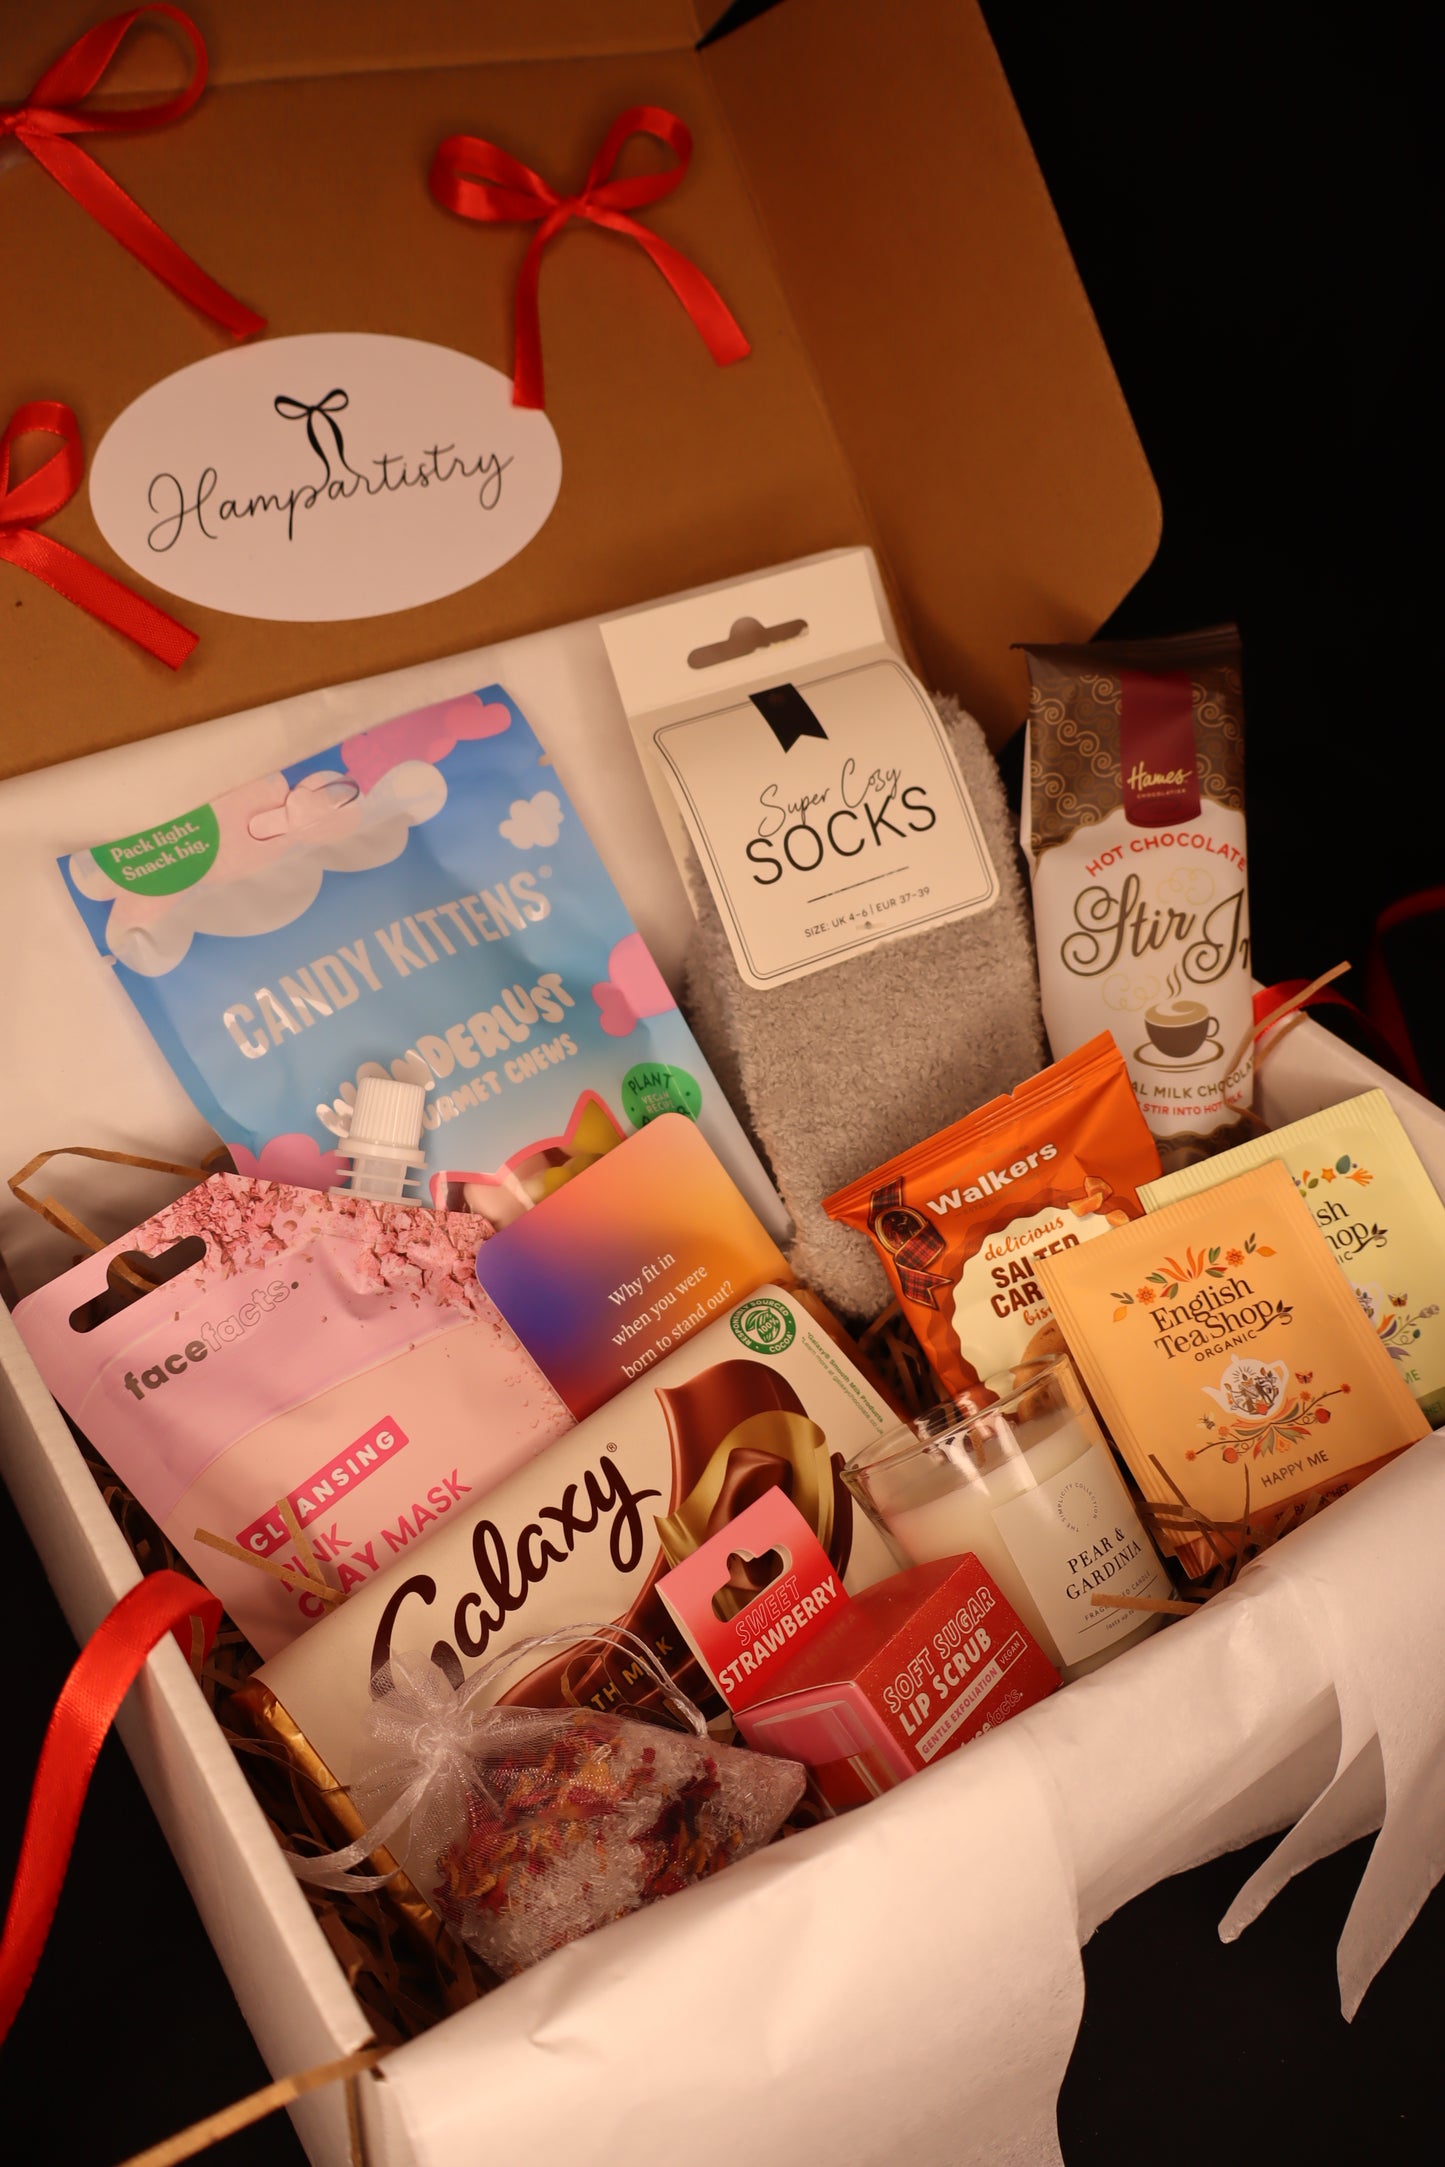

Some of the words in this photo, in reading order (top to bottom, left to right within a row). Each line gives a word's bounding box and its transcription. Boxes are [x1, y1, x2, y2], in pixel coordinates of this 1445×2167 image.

[147, 443, 514, 552] Hampartistry
[758, 784, 830, 837] Super
[841, 758, 901, 809] Cozy
[1127, 761, 1192, 791] Hames
[109, 836, 155, 862] Pack
[150, 819, 200, 848] light.
[121, 853, 176, 881] Snack
[176, 839, 210, 864] big.
[746, 786, 936, 885] SOCKS
[1085, 846, 1123, 877] HOT
[1130, 832, 1247, 872] CHOCOLATE
[804, 923, 830, 938] SIZE:
[832, 916, 846, 929] UK
[848, 908, 868, 922] 4-6
[876, 898, 897, 913] EUR
[899, 886, 930, 905] 37-39
[1061, 873, 1196, 977] Stir
[223, 938, 383, 1059] CANDY
[421, 1070, 502, 1135] URMET
[504, 1033, 578, 1084] CHEWS
[628, 1072, 673, 1096] PLANT
[1154, 1086, 1193, 1099] MILK
[1197, 1056, 1255, 1097] CHOCOLA
[1143, 1104, 1169, 1115] STIR
[1173, 1106, 1201, 1116] INTO
[926, 1143, 1058, 1216] Walkers
[985, 1215, 1065, 1261] delicious
[608, 1277, 645, 1307] Why
[641, 1263, 661, 1283] fit
[657, 1253, 676, 1270] in
[611, 1312, 652, 1347] when
[650, 1292, 677, 1321] you
[675, 1266, 708, 1295] were
[750, 1299, 789, 1316] SOURCED
[1149, 1277, 1255, 1333] English
[621, 1348, 658, 1379] born
[655, 1336, 672, 1352] to
[671, 1303, 707, 1340] stand
[706, 1280, 735, 1310] out?
[758, 1317, 779, 1334] 100%
[1194, 1329, 1257, 1362] ORGANIC
[249, 1430, 396, 1552] CLANSING
[1260, 1460, 1306, 1488] HAPPY
[1307, 1449, 1329, 1468] ME
[298, 1540, 380, 1618] CAY
[380, 1468, 473, 1554] MASK
[1066, 1537, 1113, 1575] PEAR
[1115, 1527, 1126, 1542] &
[1066, 1540, 1142, 1600] GARDINIA
[718, 1575, 839, 1694] STRAWBERRY
[735, 1575, 800, 1647] SWEET
[883, 1647, 935, 1714] SOFT
[933, 1586, 996, 1660] SUGAR
[899, 1692, 931, 1736] LIP
[932, 1627, 992, 1700] SCRUB
[922, 1721, 952, 1754] GENTLE
[950, 1667, 998, 1722] EXFOLIATION
[1000, 1641, 1021, 1665] VEGAN
